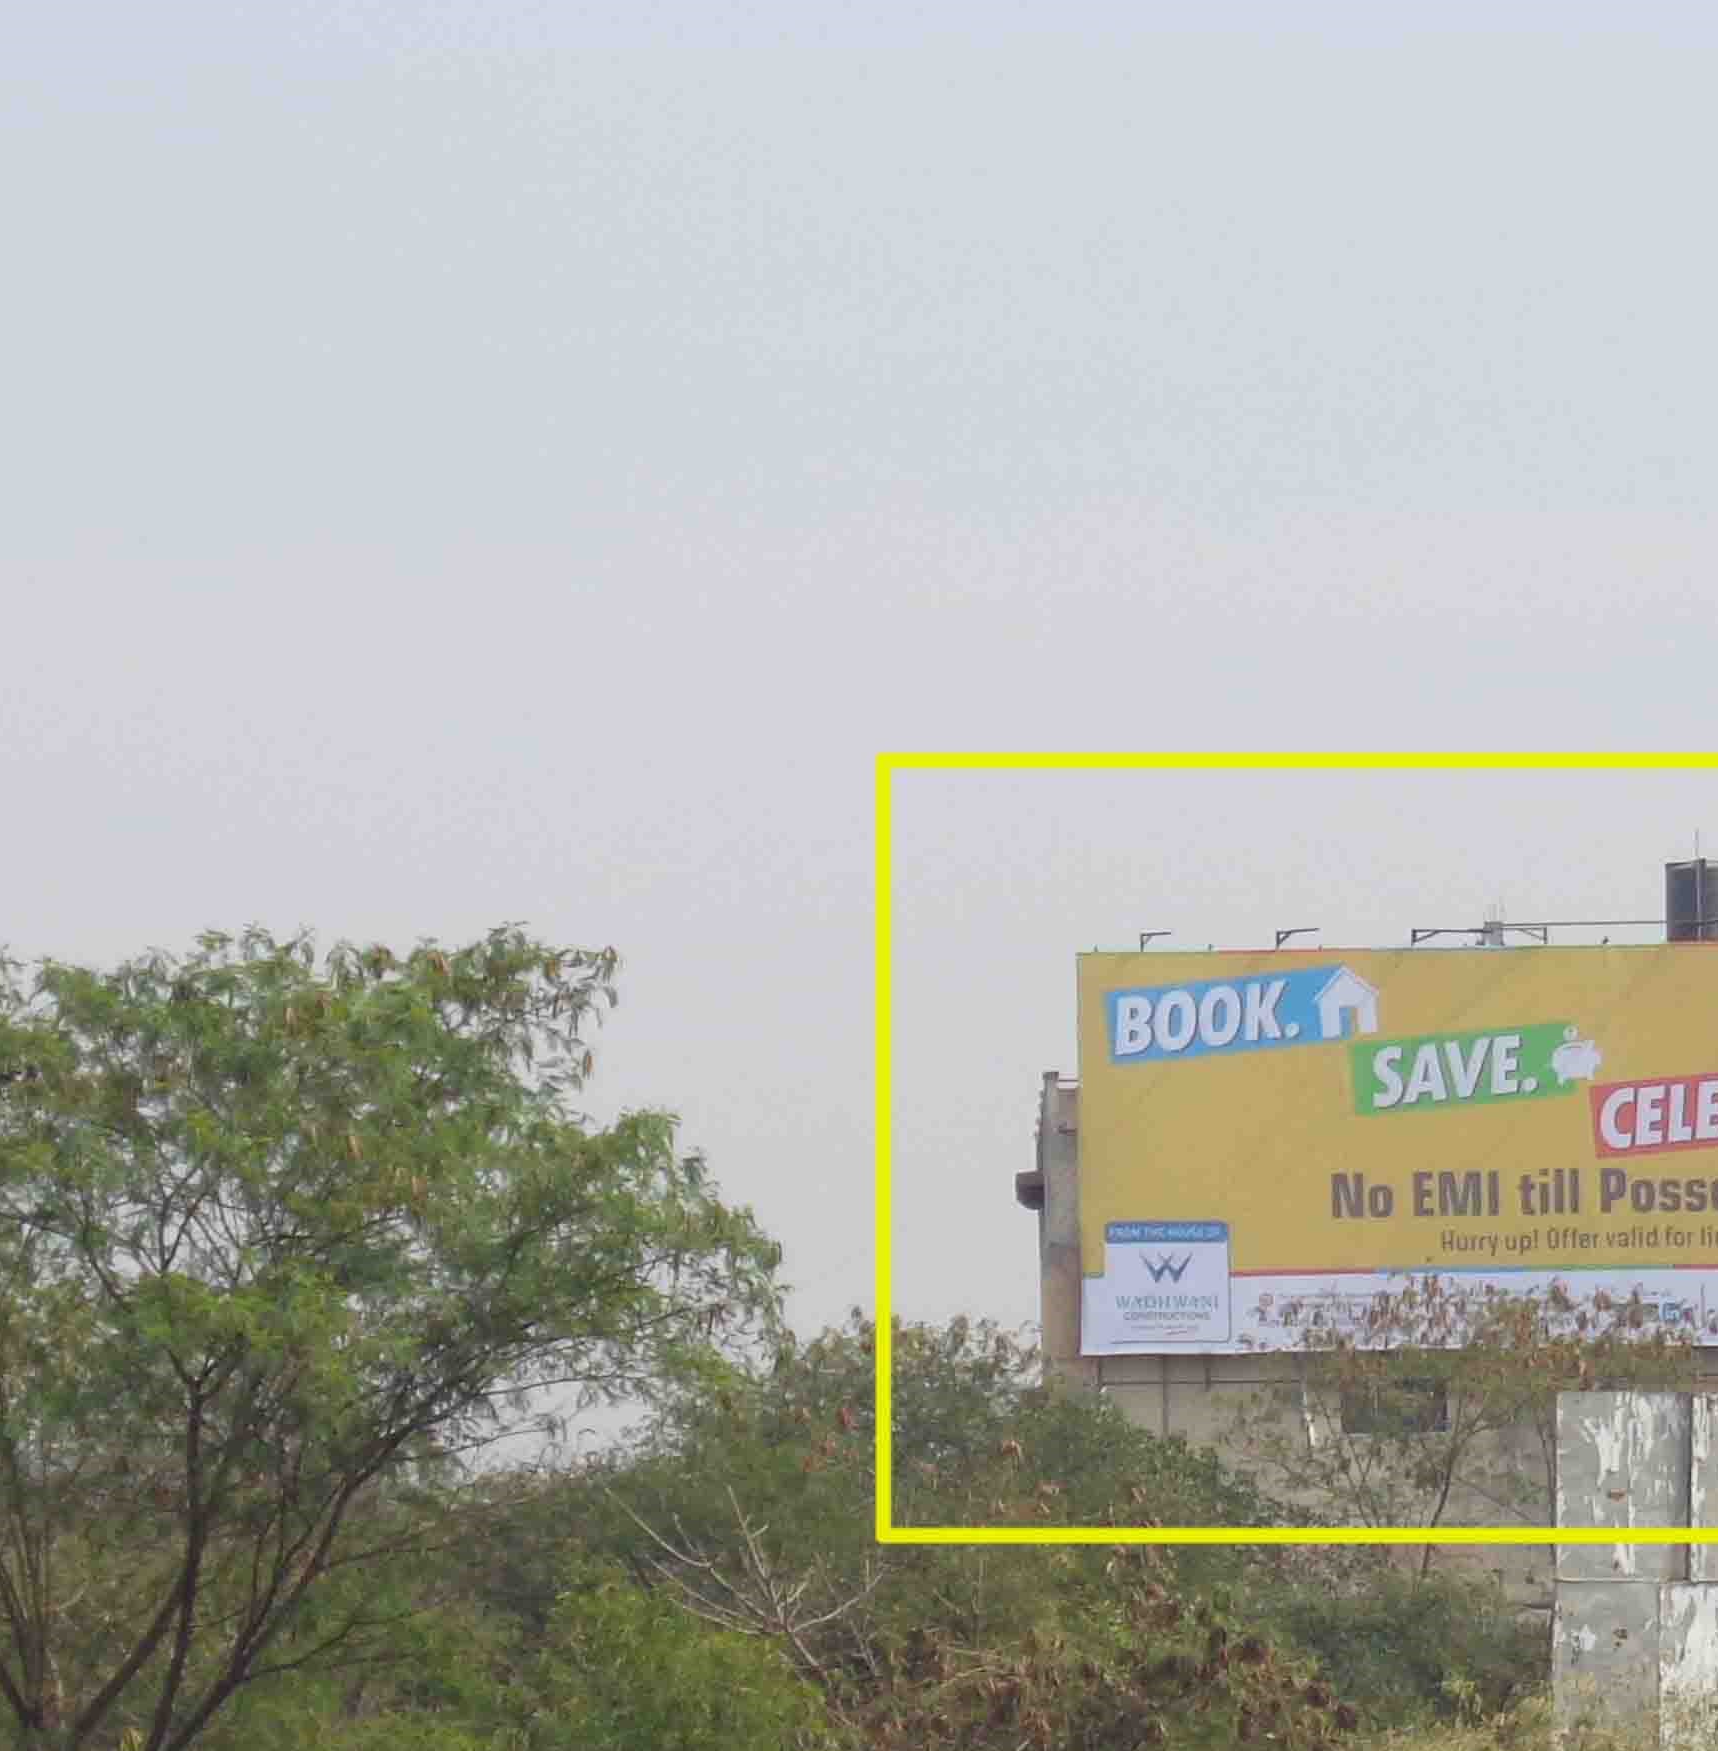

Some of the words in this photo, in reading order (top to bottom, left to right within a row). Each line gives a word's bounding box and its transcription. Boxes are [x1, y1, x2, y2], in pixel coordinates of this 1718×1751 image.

[1115, 979, 1300, 1056] BOOK.
[1373, 1034, 1538, 1108] SAVE.
[1331, 1171, 1394, 1218] No
[1413, 1170, 1500, 1217] EMI
[1519, 1168, 1580, 1215] till
[1442, 1229, 1499, 1256] Hurry
[1505, 1228, 1539, 1254] up!
[1547, 1226, 1598, 1249] Offer
[1607, 1226, 1659, 1248] valid
[1666, 1225, 1693, 1248] for
